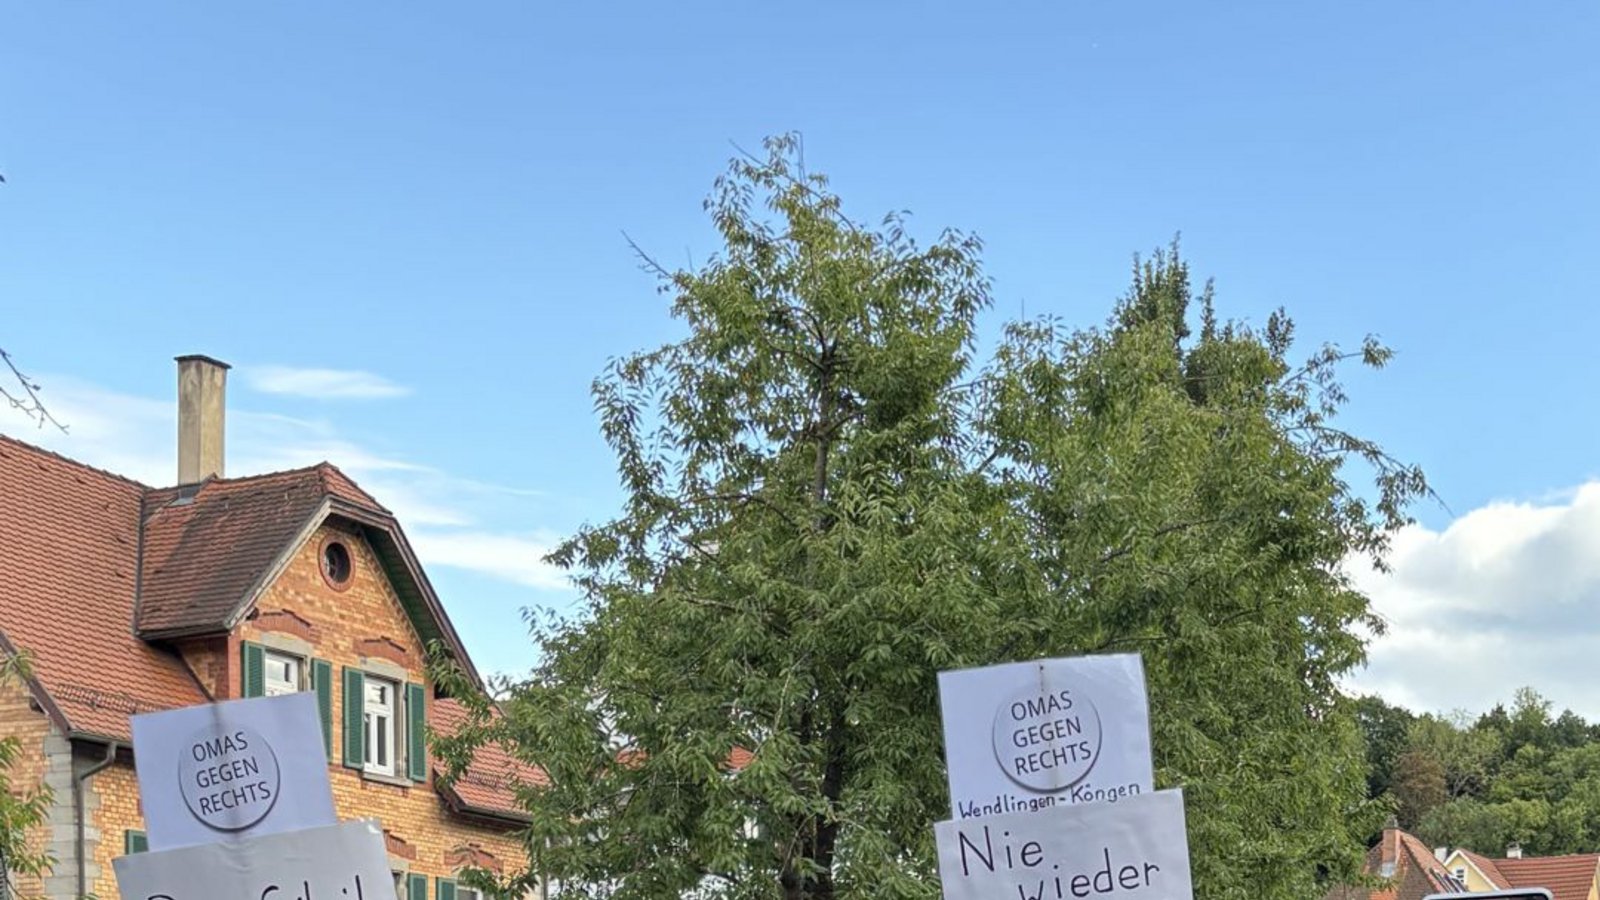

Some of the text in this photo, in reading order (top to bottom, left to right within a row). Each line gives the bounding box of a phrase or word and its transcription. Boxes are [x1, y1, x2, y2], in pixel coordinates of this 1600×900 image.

[1011, 690, 1073, 721] OMAS
[192, 731, 248, 762] OMAS
[1013, 716, 1082, 748] GEGEN
[196, 756, 259, 789] GEGEN
[1014, 741, 1091, 776] RECHTS
[199, 781, 271, 816] RECHTS
[958, 825, 1044, 876] Nie
